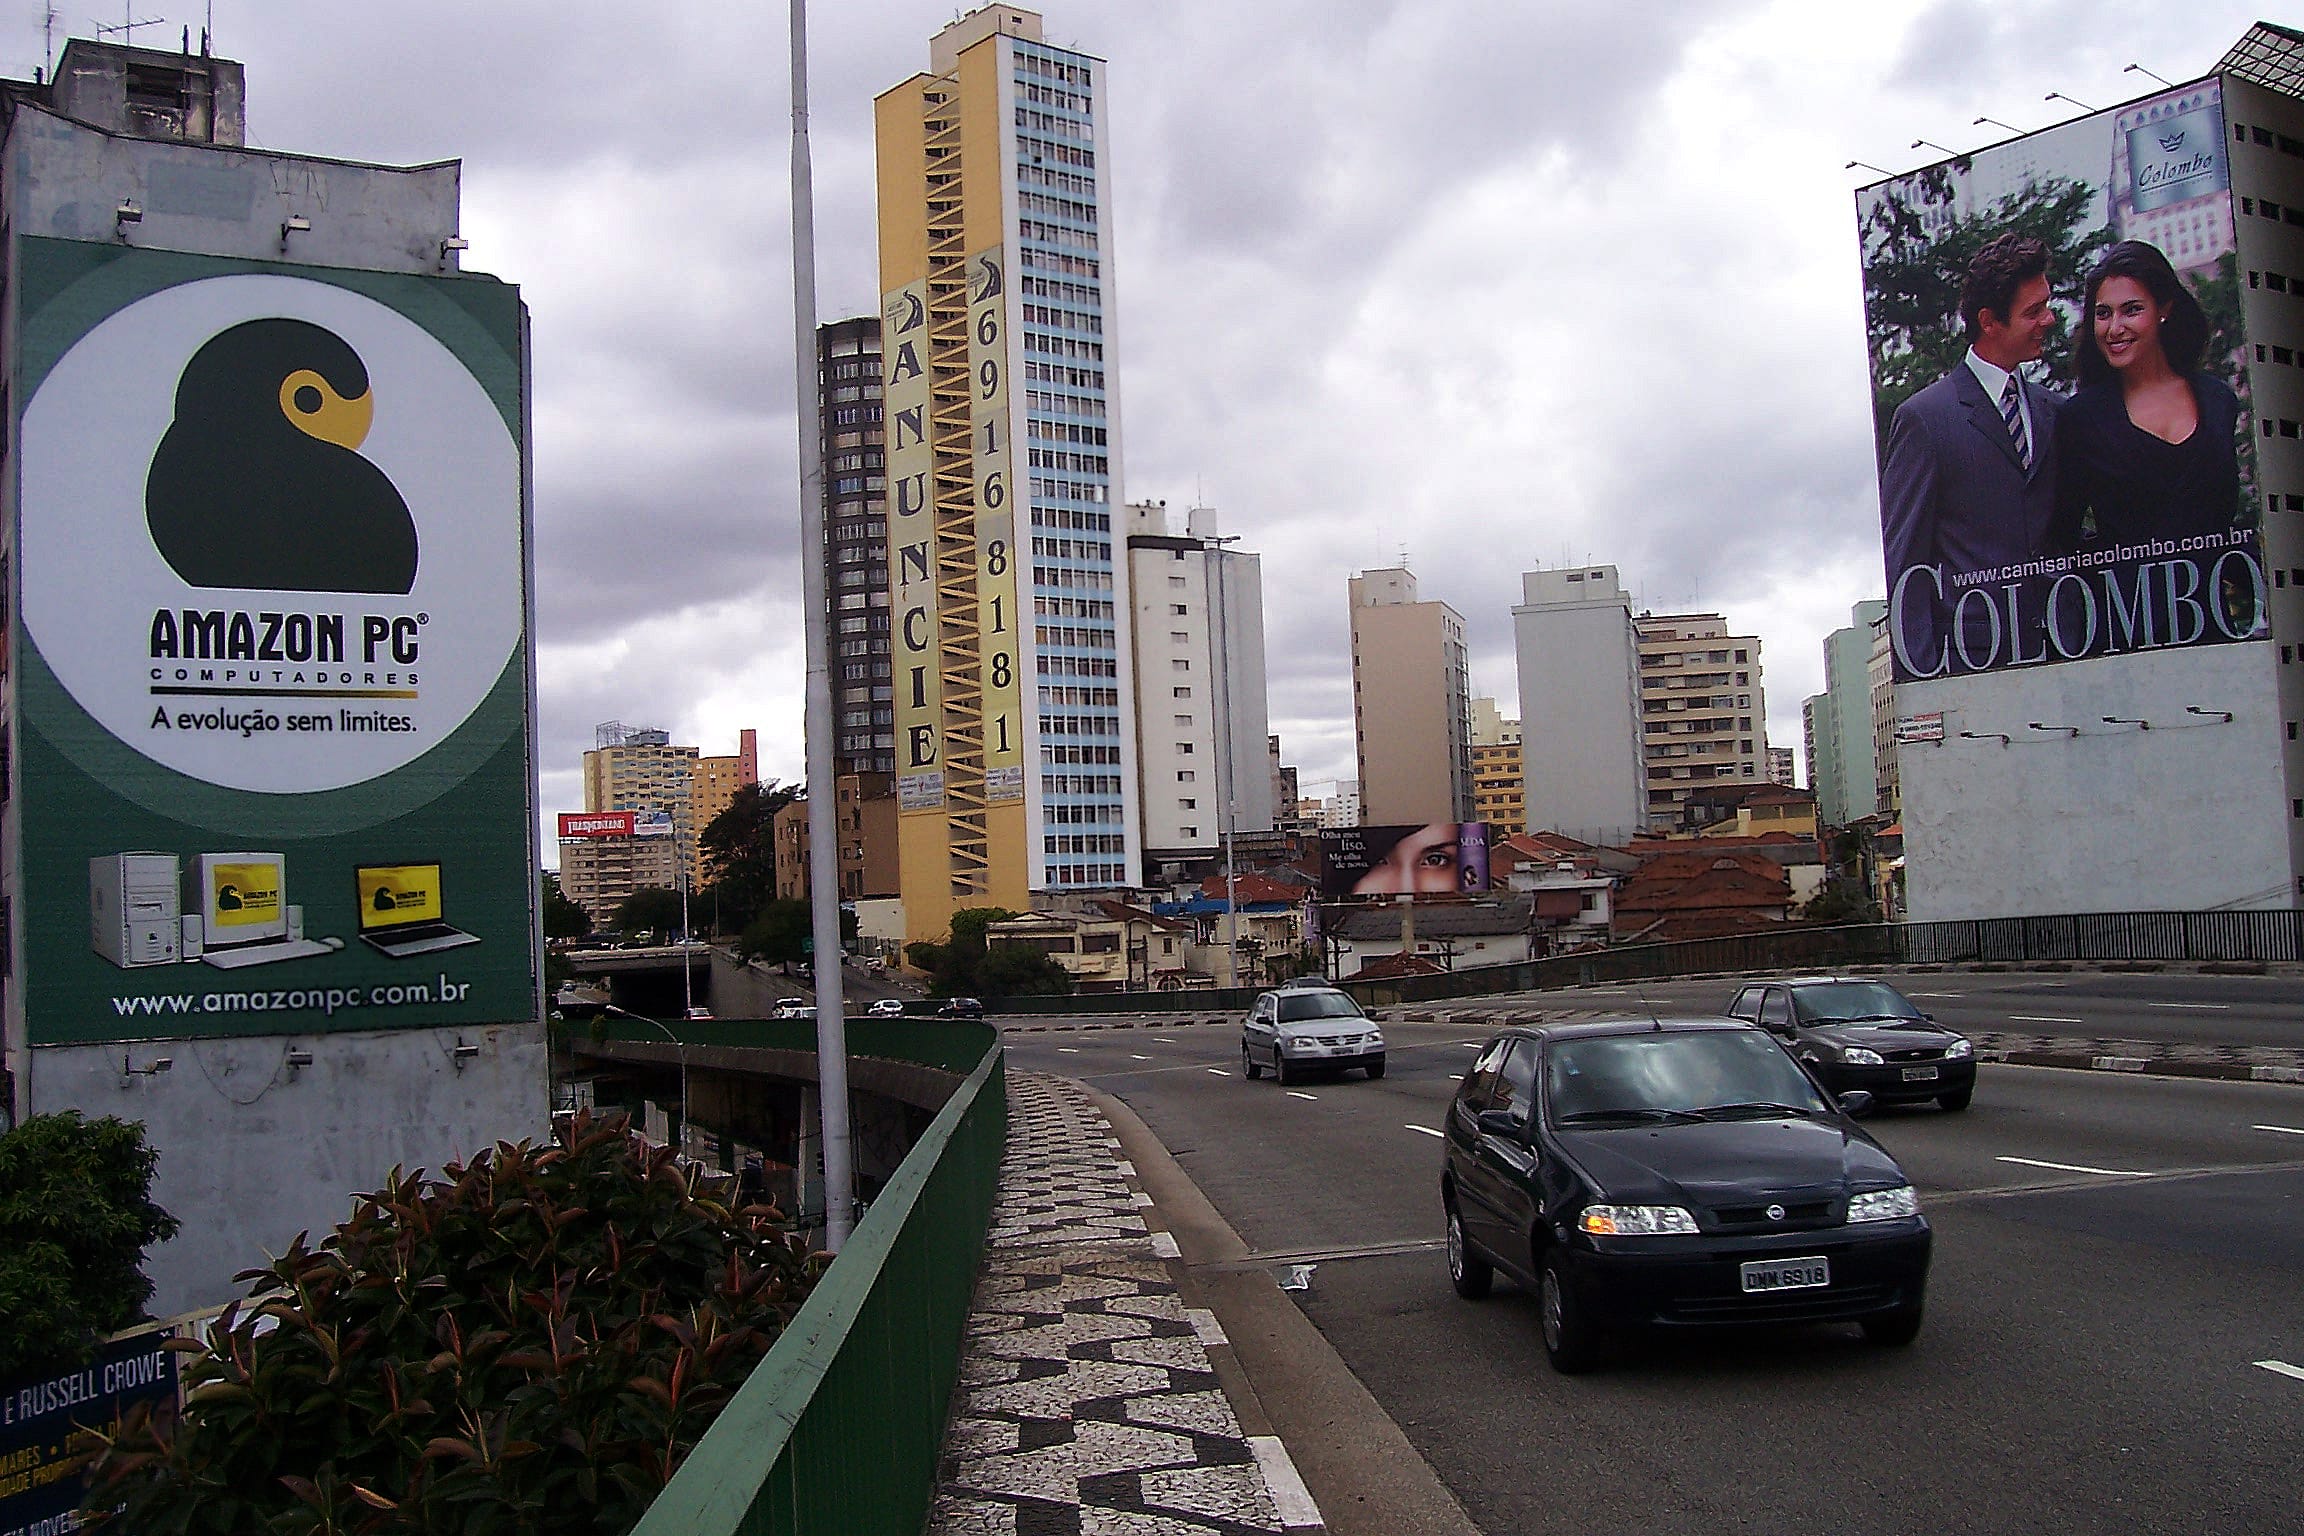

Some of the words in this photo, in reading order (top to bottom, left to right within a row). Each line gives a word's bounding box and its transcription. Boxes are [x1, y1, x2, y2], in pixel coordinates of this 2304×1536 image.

[2138, 152, 2213, 186] Colombo
[888, 340, 938, 768] ANUNCIE
[1952, 525, 2255, 588] www.camisariacolombo.com.br
[149, 608, 345, 663] AMAZON
[1890, 550, 2269, 679] COLOMBO
[149, 669, 420, 686] COMPUTADORES
[150, 706, 171, 730] A
[178, 708, 280, 737] evolução
[286, 713, 333, 732] sem
[340, 708, 417, 733] limites.
[1341, 838, 1367, 851] liso.
[1460, 837, 1485, 847] SEDA
[112, 974, 471, 1016] www.amazonpc.com.br
[19, 1369, 99, 1421] RUSSELL
[104, 1350, 166, 1394] CROWE
